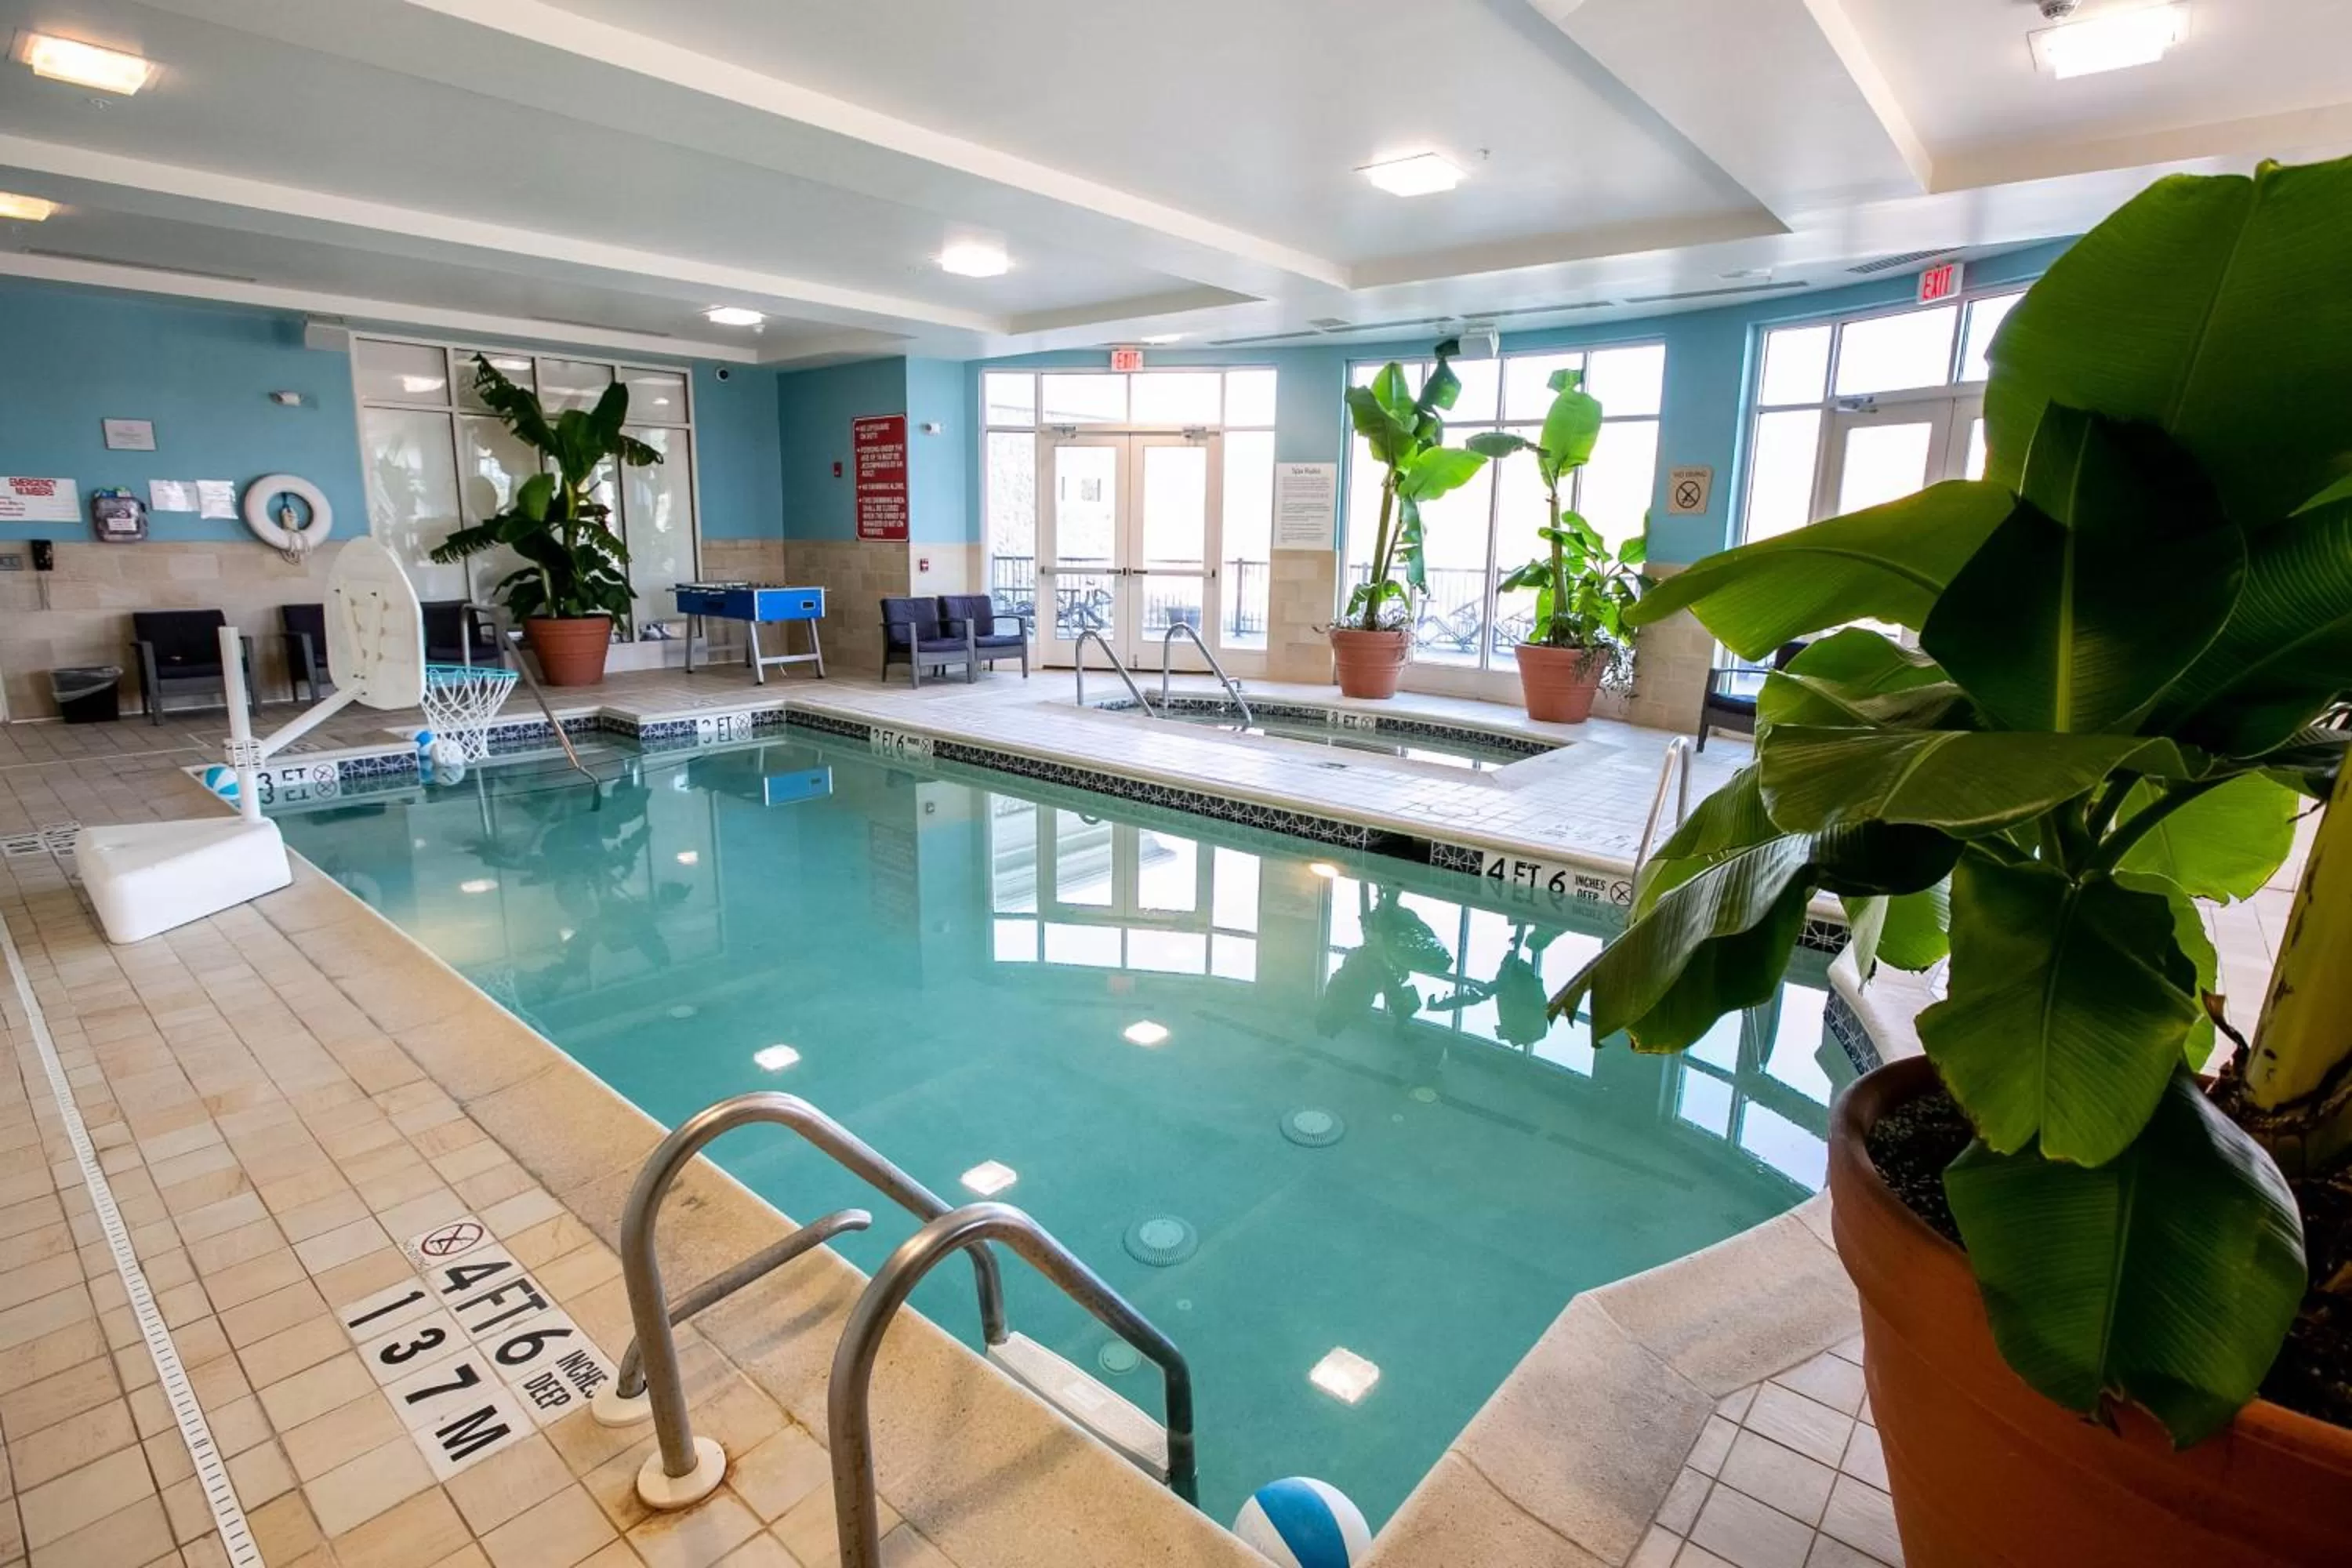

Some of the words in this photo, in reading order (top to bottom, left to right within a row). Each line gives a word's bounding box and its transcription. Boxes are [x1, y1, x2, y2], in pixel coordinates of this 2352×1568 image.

[1922, 264, 1954, 301] EXIT
[1116, 353, 1138, 369] EXIT
[1486, 857, 1506, 881] 4
[1513, 861, 1542, 888] FT
[1548, 869, 1567, 894] 6
[1574, 874, 1607, 891] INCHES
[440, 1260, 514, 1296] 4
[454, 1276, 550, 1334] FT
[494, 1328, 575, 1366] 6
[522, 1371, 572, 1410] DEEP
